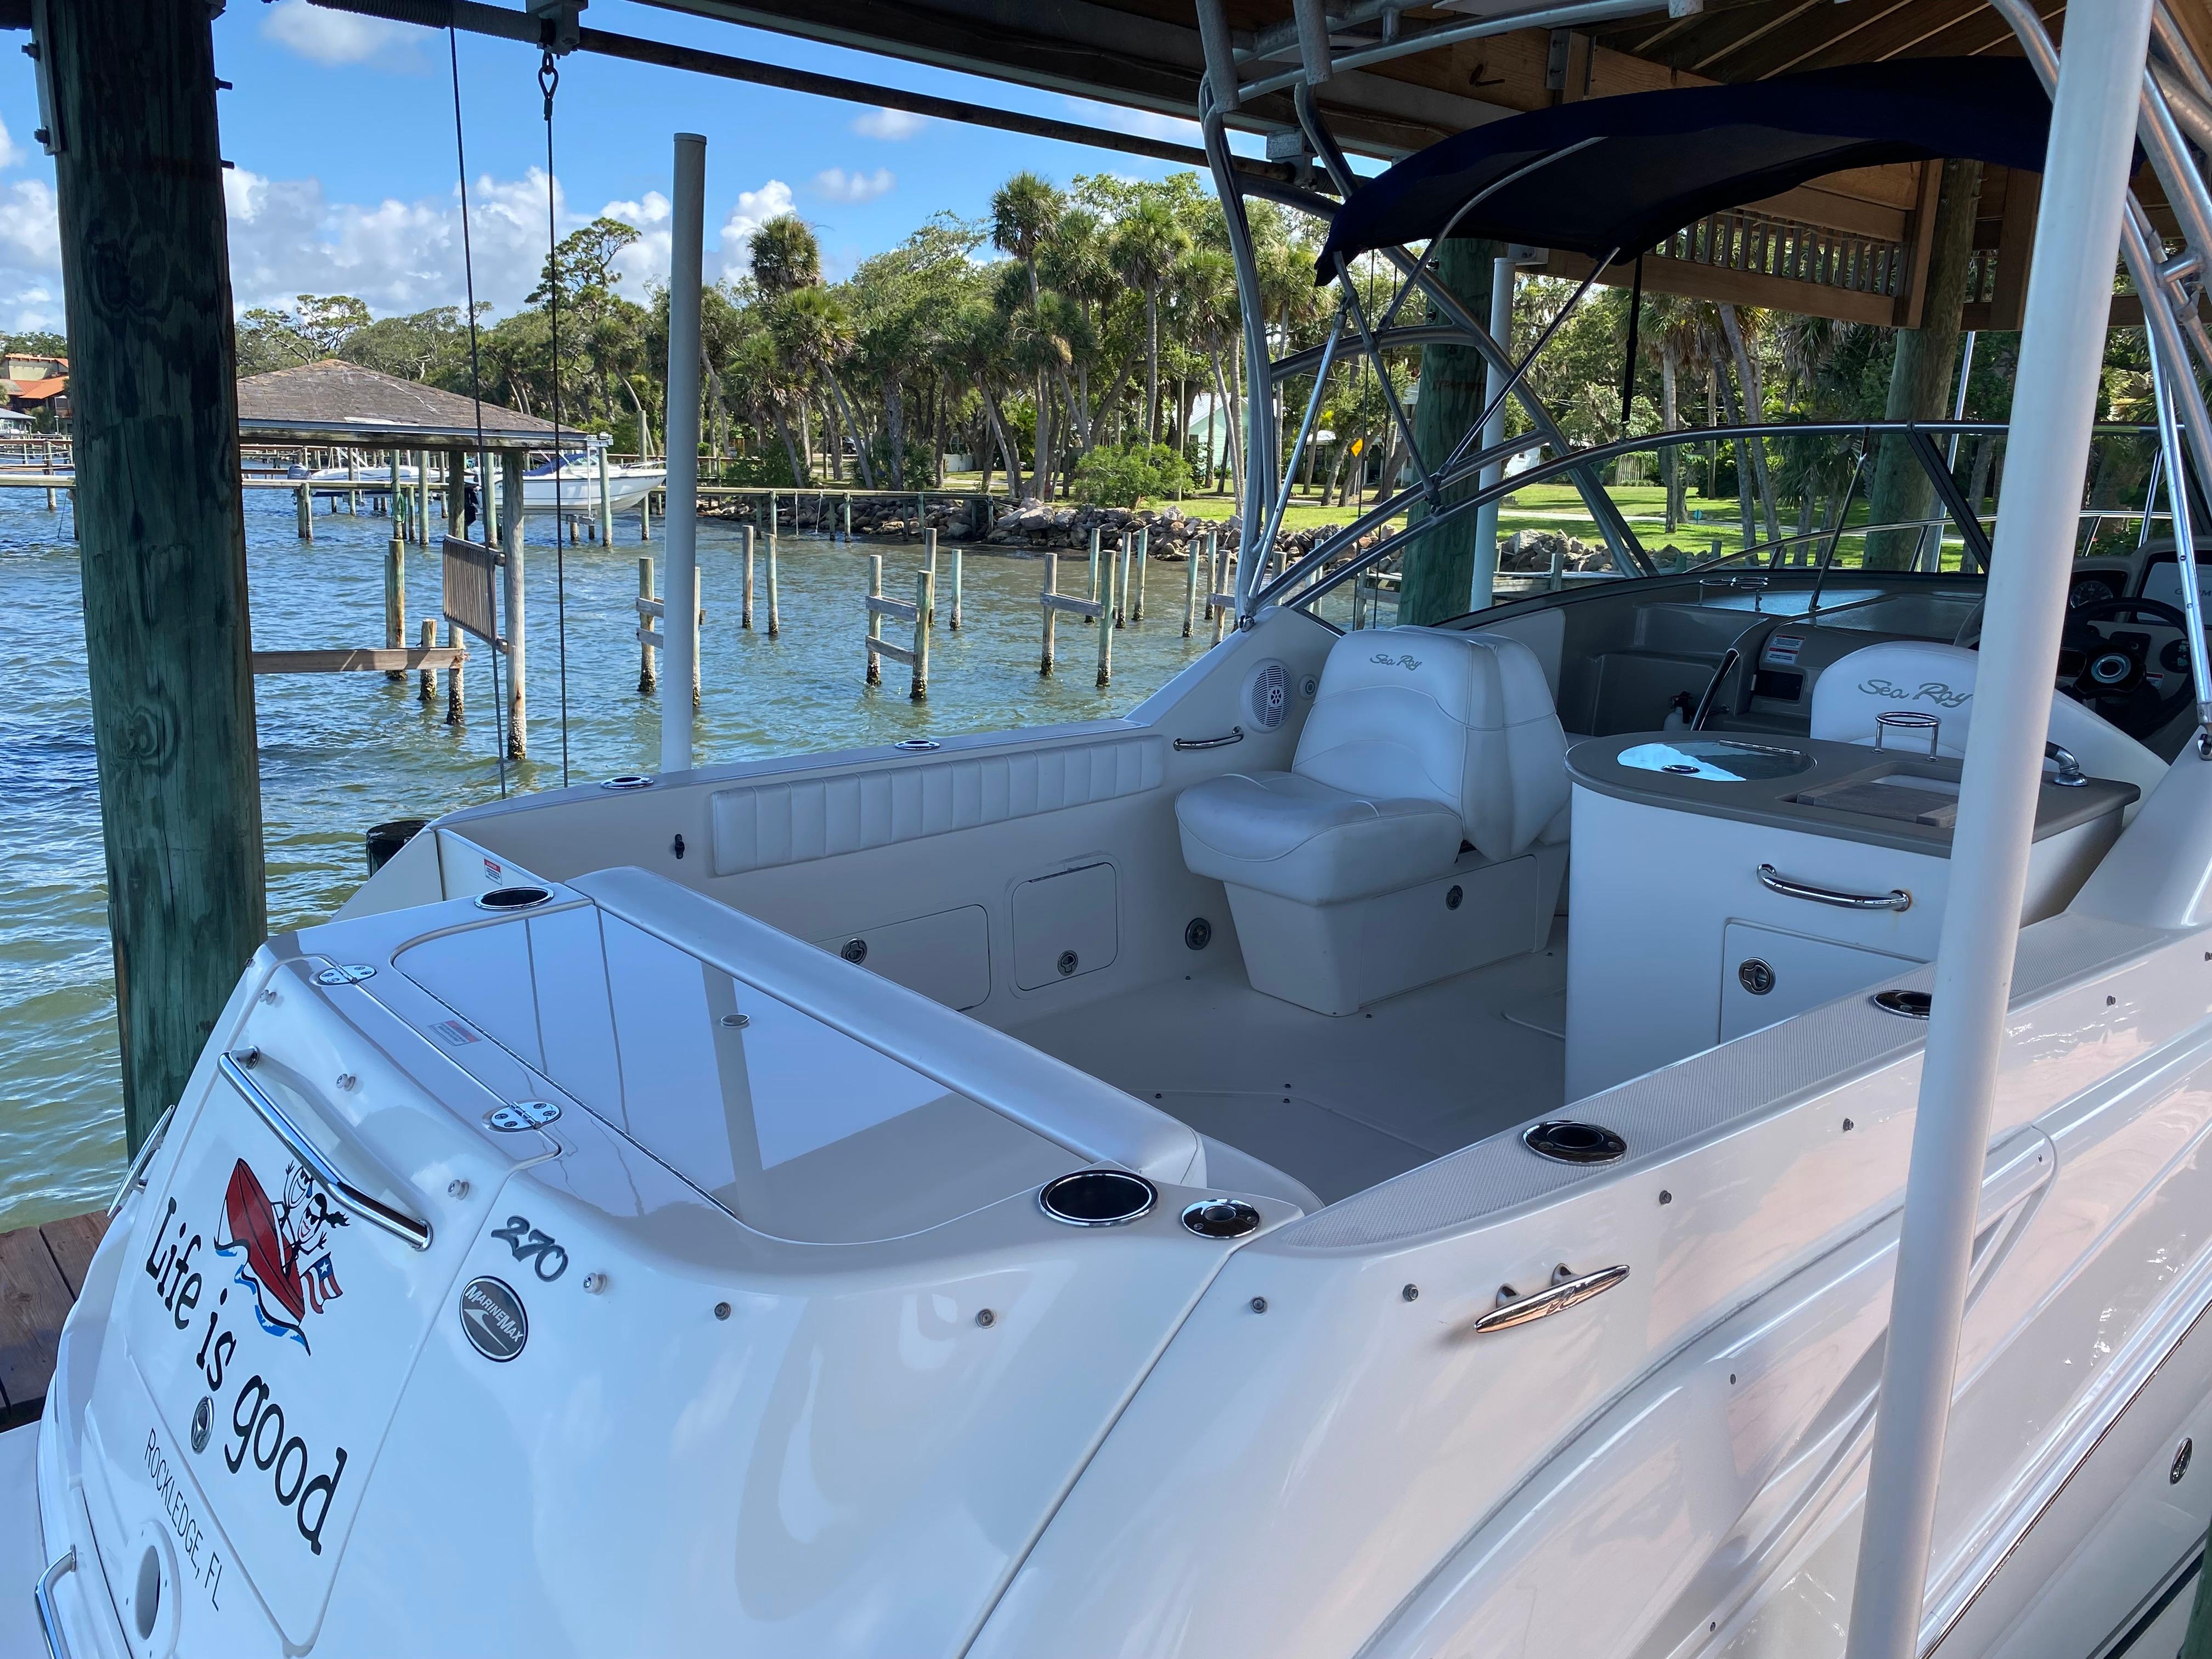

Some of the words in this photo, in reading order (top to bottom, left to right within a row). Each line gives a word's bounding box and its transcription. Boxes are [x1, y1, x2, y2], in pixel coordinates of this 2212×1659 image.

[1369, 654, 1396, 665] Sea
[1396, 655, 1423, 671] Ray
[1858, 679, 1910, 699] Sea
[1912, 682, 1973, 708] Ray
[490, 1215, 568, 1282] 270
[146, 1197, 202, 1329] Life
[196, 1288, 237, 1392] is
[224, 1375, 348, 1556] good
[144, 1427, 204, 1580] ROCKLEDGE,
[205, 1551, 222, 1612] FL
